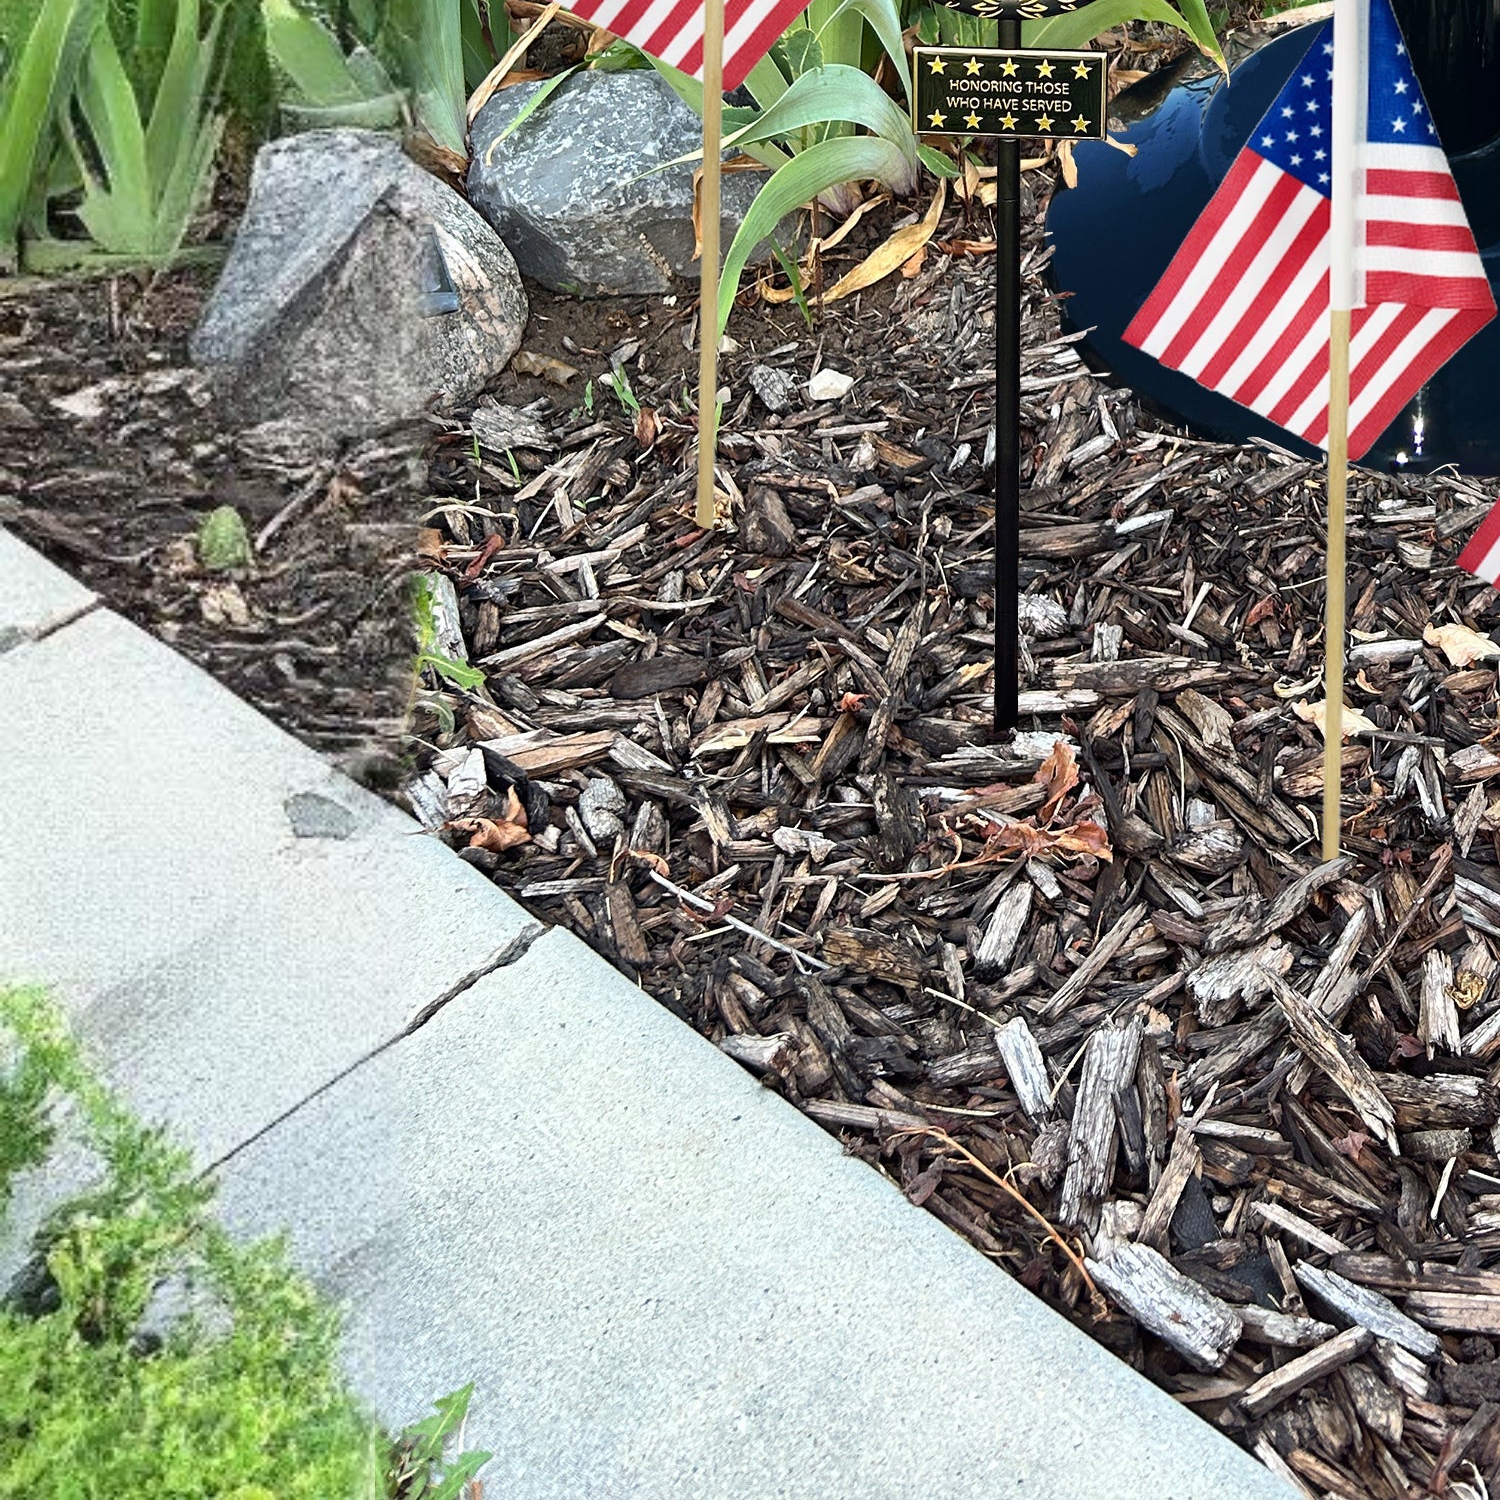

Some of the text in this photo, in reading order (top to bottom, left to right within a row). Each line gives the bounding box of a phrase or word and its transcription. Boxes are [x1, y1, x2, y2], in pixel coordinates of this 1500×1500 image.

[949, 79, 1070, 95] HONORING THOSE
[946, 97, 1072, 112] WHO HAVE SERVED
